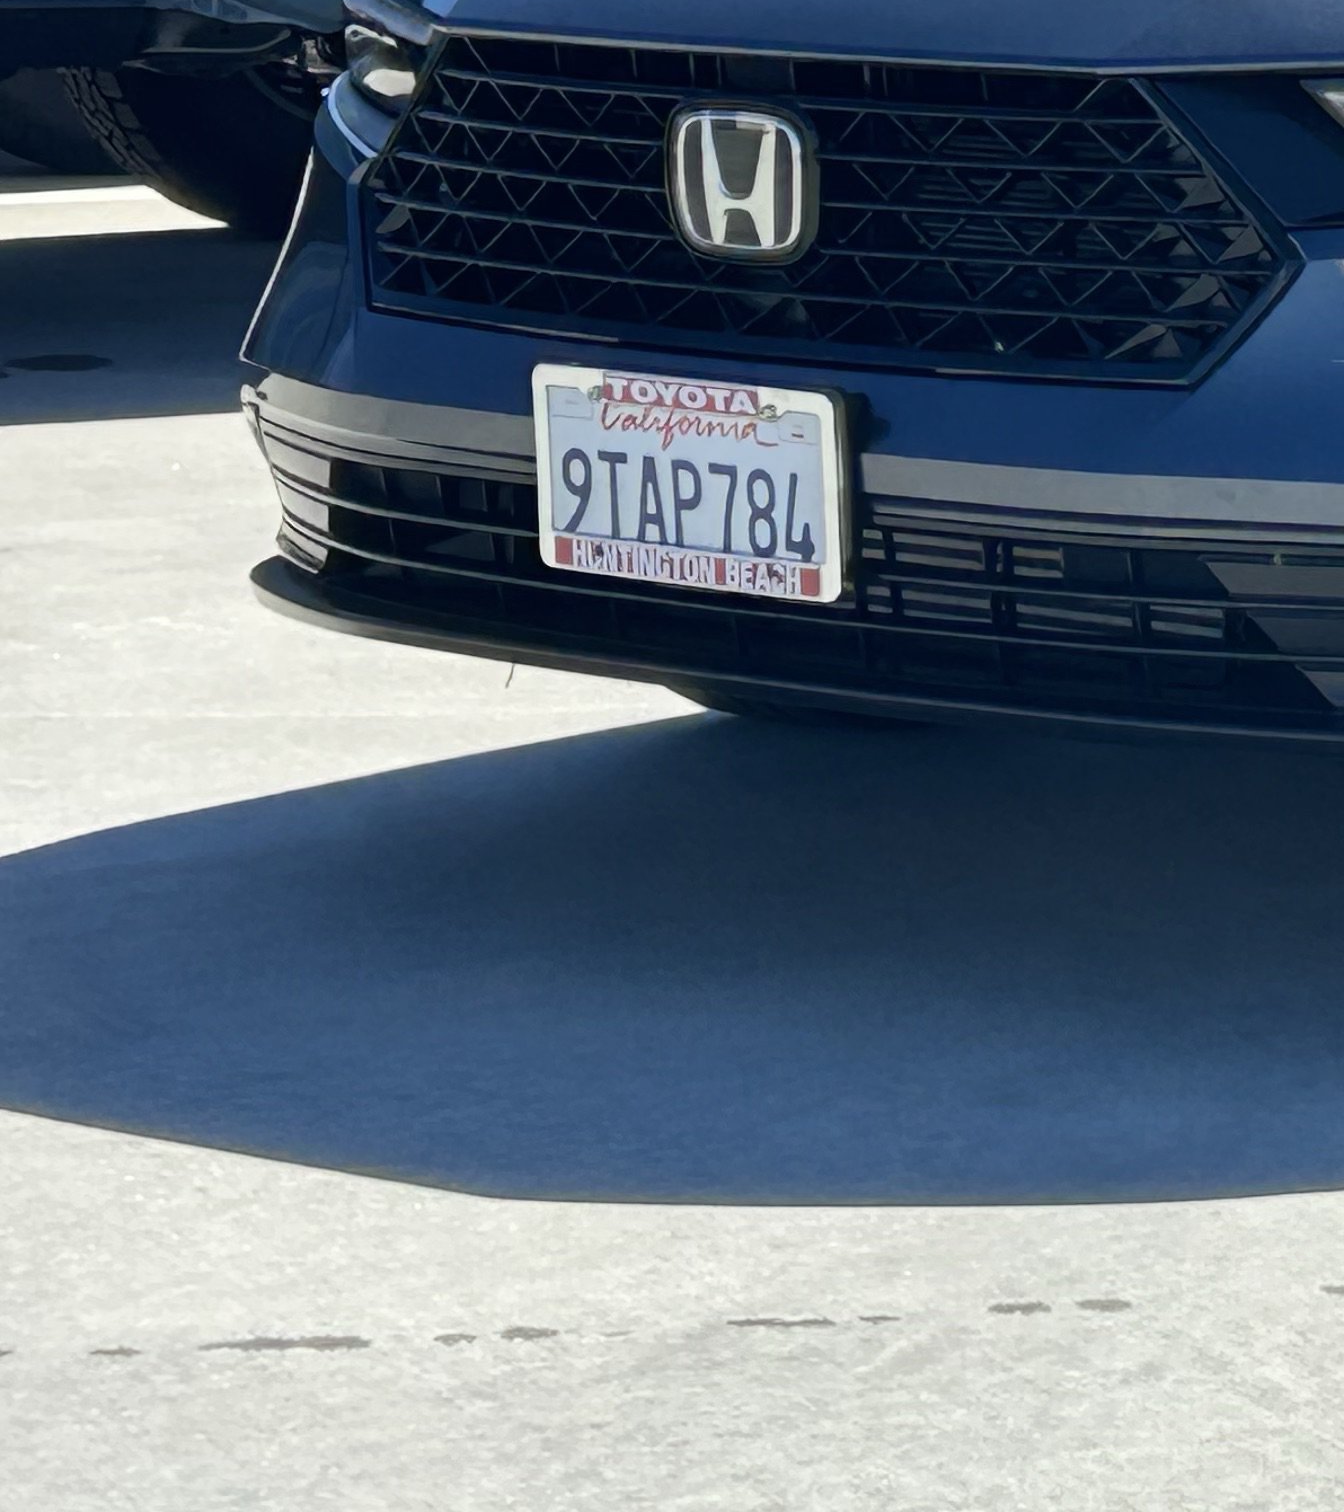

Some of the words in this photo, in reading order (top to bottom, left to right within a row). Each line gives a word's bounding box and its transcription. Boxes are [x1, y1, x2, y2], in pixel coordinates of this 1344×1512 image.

[605, 377, 758, 415] TOYOTA
[600, 400, 779, 451] California
[561, 447, 816, 563] 9TAP784
[572, 538, 716, 585] HUNTINGTON
[725, 557, 800, 595] BEACH
